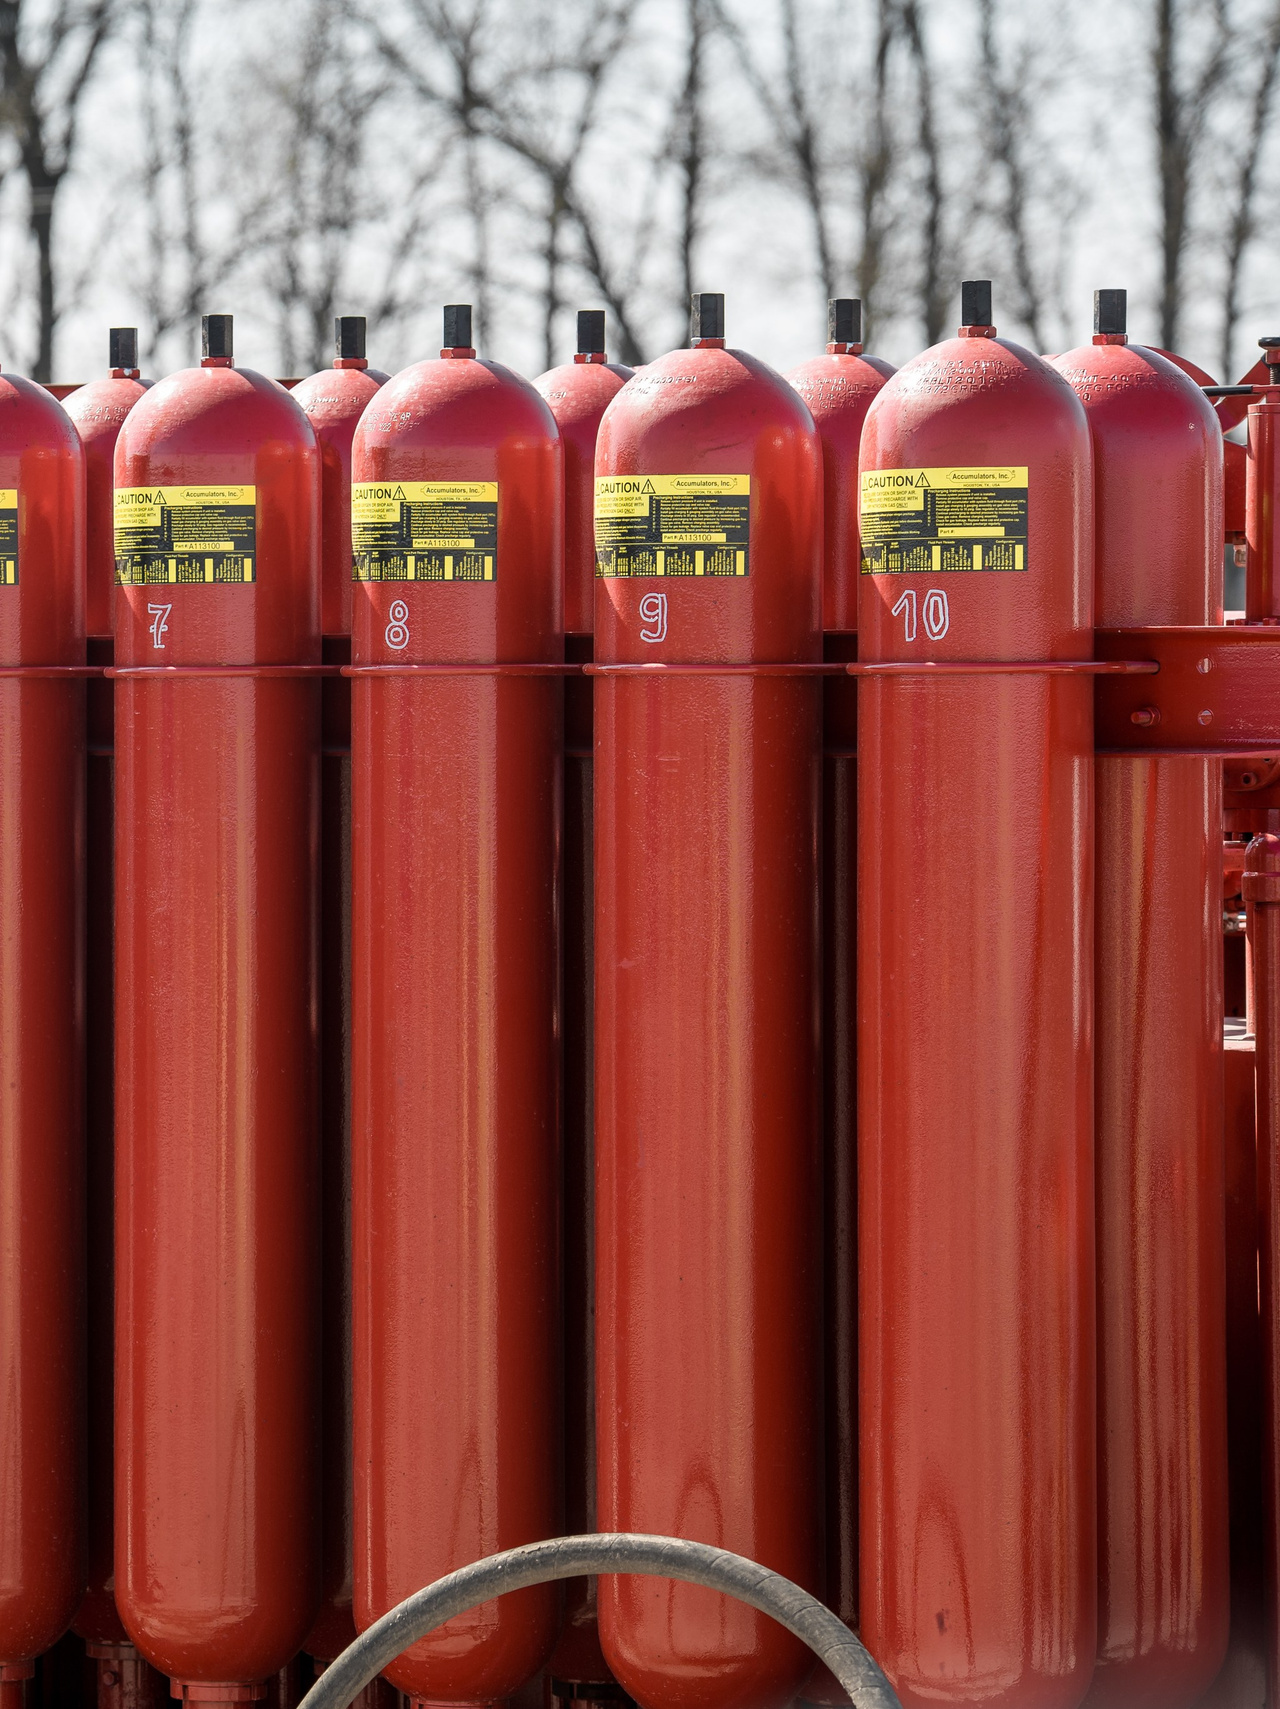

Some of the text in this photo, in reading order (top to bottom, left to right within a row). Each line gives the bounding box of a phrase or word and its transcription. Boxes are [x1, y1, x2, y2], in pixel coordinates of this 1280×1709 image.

[601, 482, 640, 494] CAUTION
[868, 475, 914, 488] CAUTION
[147, 602, 172, 648] 7
[384, 599, 410, 650] 8
[891, 588, 950, 642] 10
